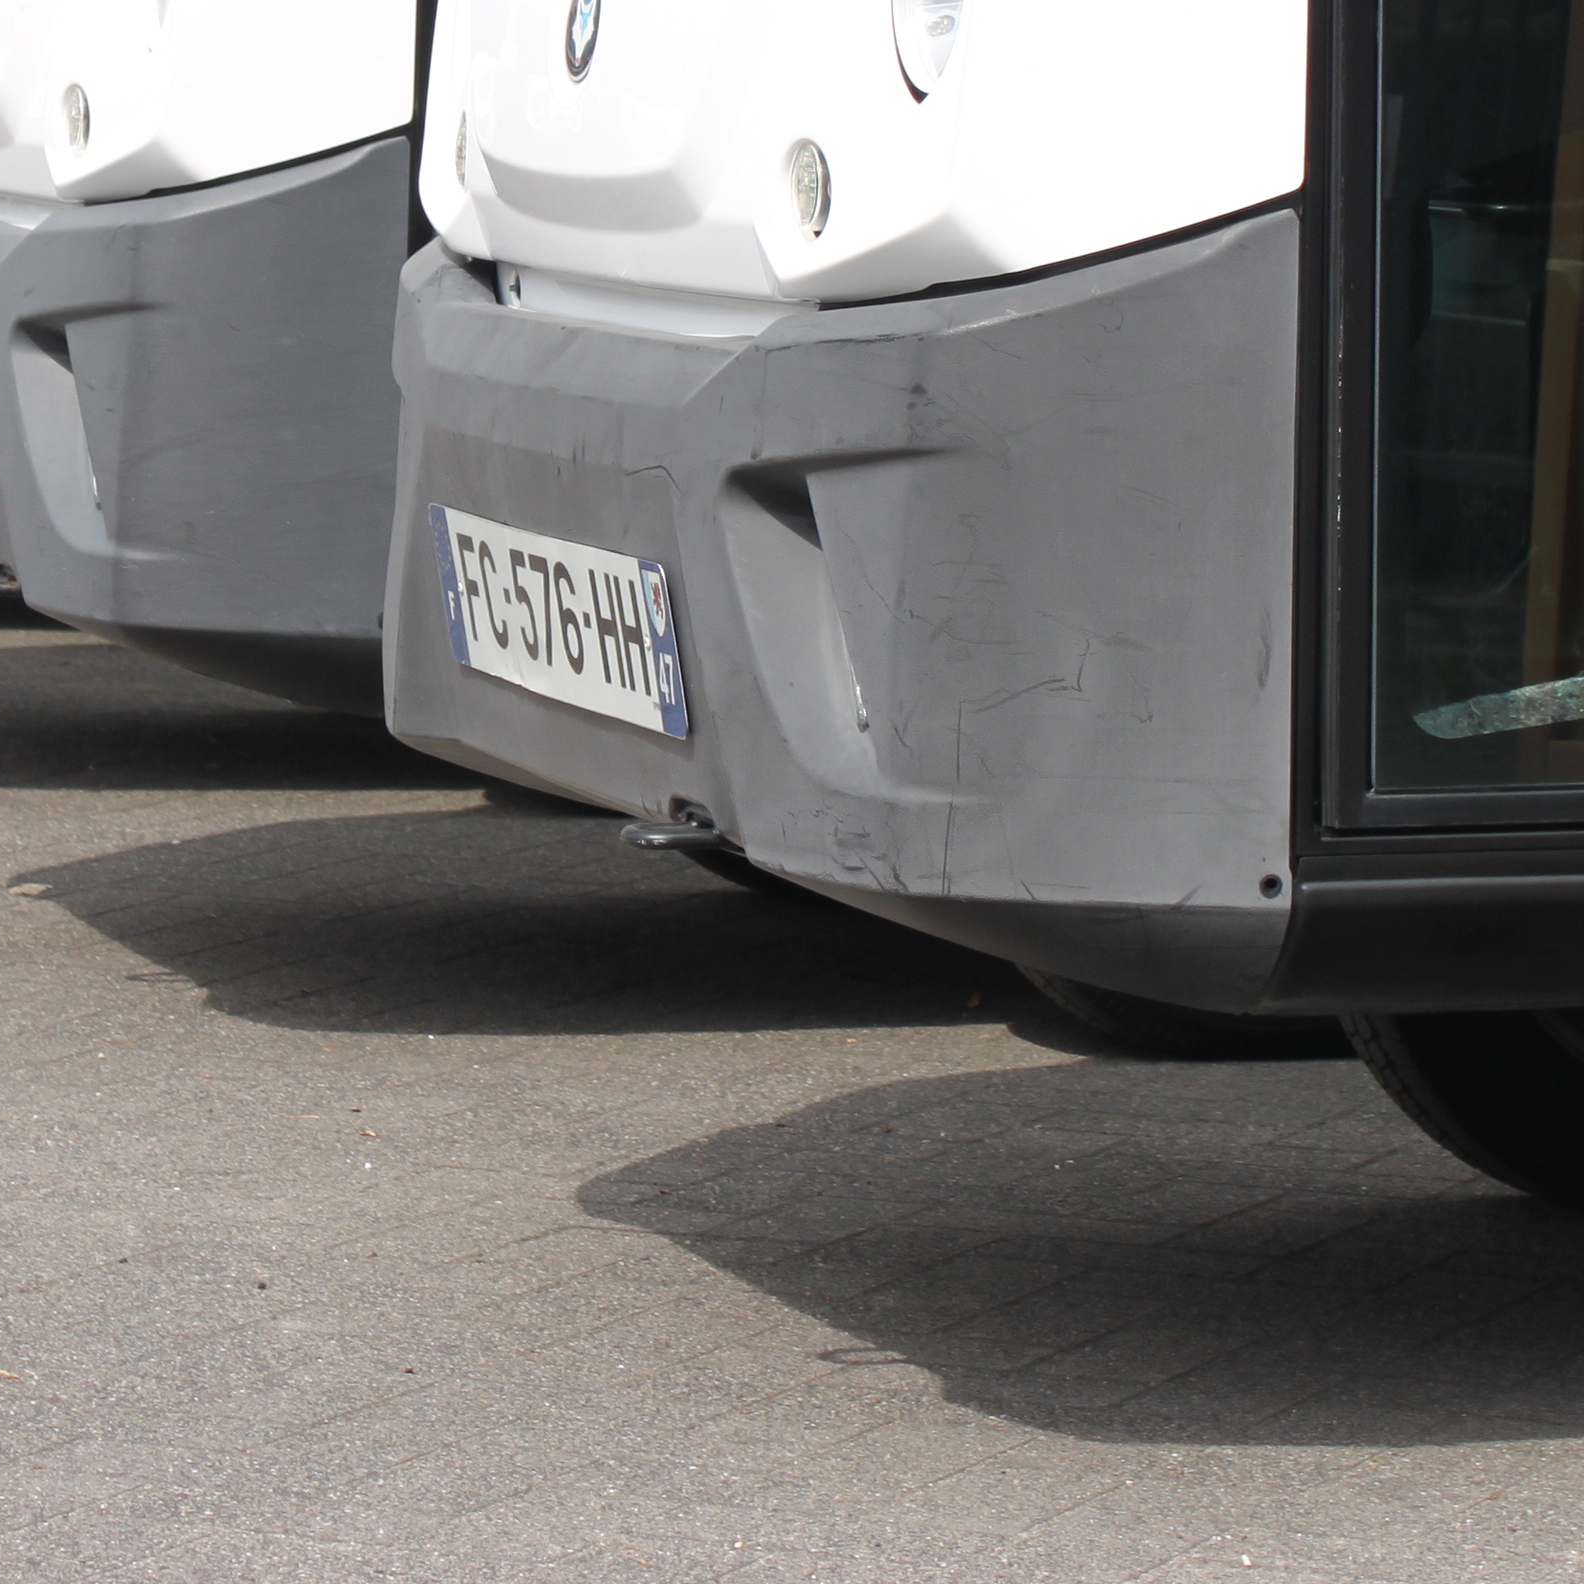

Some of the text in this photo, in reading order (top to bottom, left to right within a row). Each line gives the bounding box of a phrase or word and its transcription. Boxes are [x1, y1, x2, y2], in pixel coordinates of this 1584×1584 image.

[447, 590, 456, 621] F
[456, 532, 652, 697] FC-576-HH
[659, 652, 677, 706] 47
